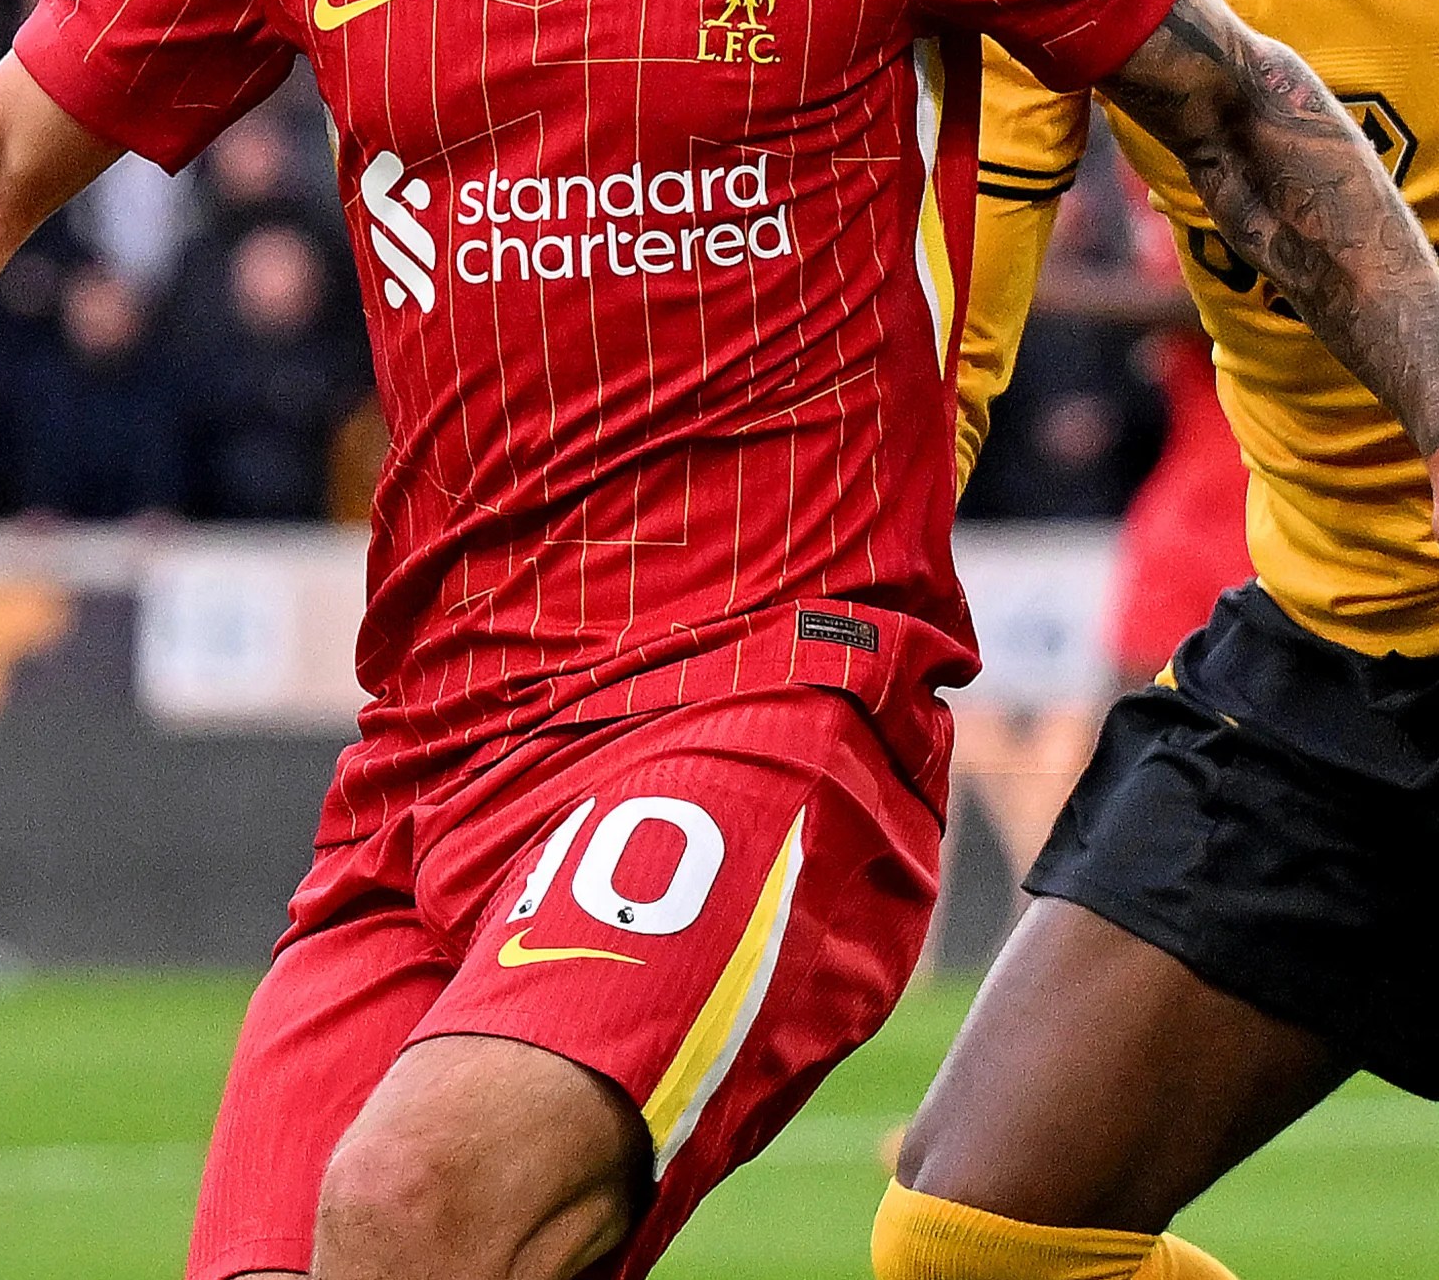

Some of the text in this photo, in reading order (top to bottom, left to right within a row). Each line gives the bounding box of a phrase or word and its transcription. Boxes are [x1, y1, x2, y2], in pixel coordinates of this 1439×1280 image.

[456, 153, 771, 224] standard
[455, 203, 795, 283] chartered
[506, 795, 725, 935] 10
